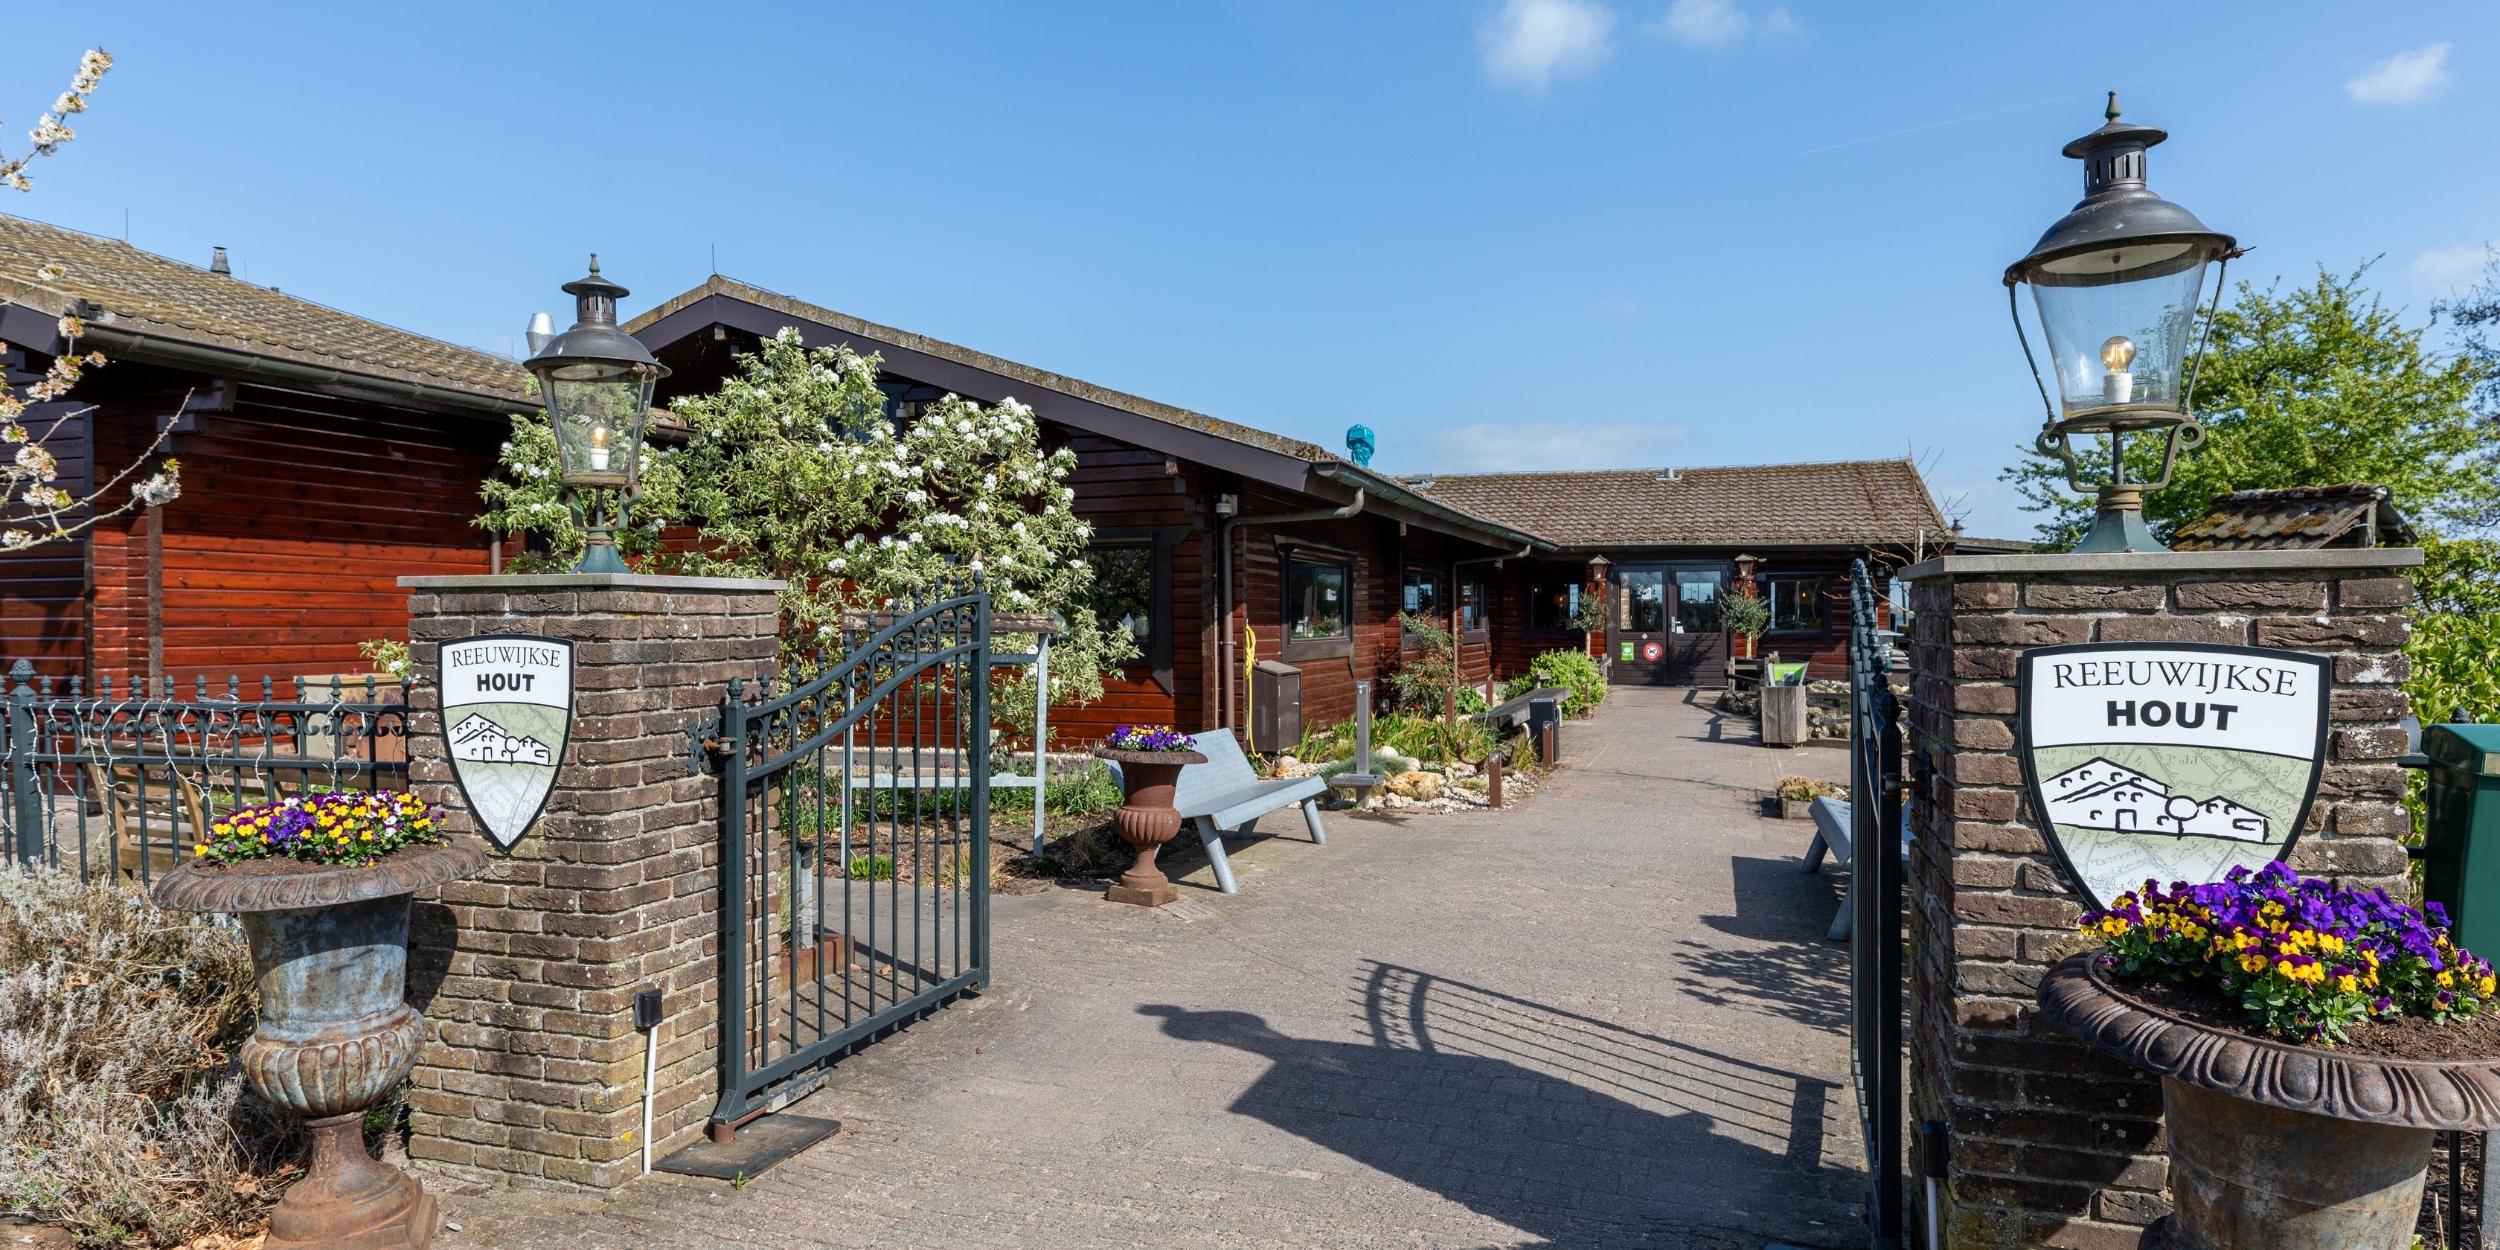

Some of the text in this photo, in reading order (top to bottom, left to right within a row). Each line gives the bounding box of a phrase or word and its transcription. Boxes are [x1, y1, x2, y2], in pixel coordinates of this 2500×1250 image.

[451, 646, 561, 668] REEUWIJKSE
[476, 673, 535, 692] HOUT
[2053, 660, 2298, 697] REEUWIJKSE
[2106, 700, 2239, 731] HOUT
